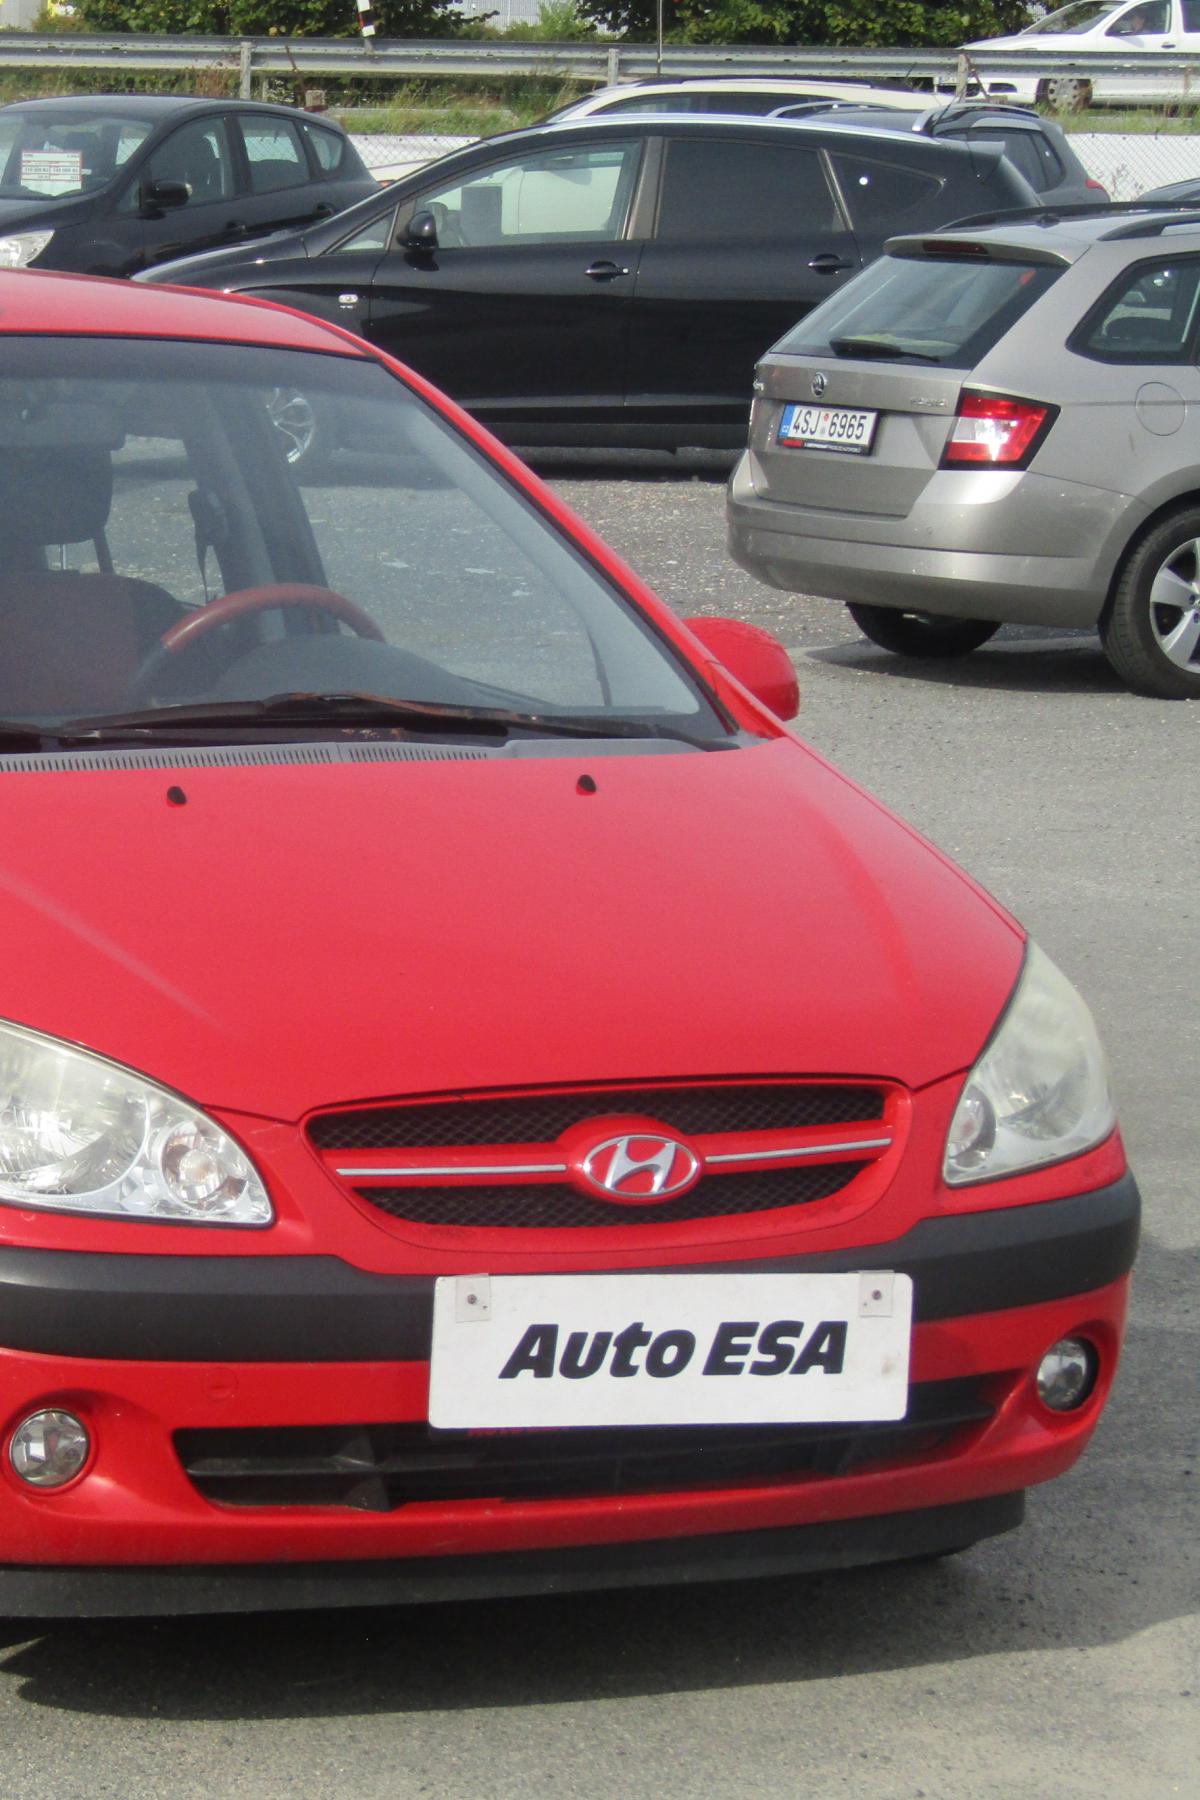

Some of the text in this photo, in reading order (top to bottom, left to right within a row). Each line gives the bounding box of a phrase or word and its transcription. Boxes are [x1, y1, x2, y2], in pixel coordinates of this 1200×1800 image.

[793, 409, 867, 439] 4SJ 6965
[498, 1320, 848, 1379] Auto ESA
